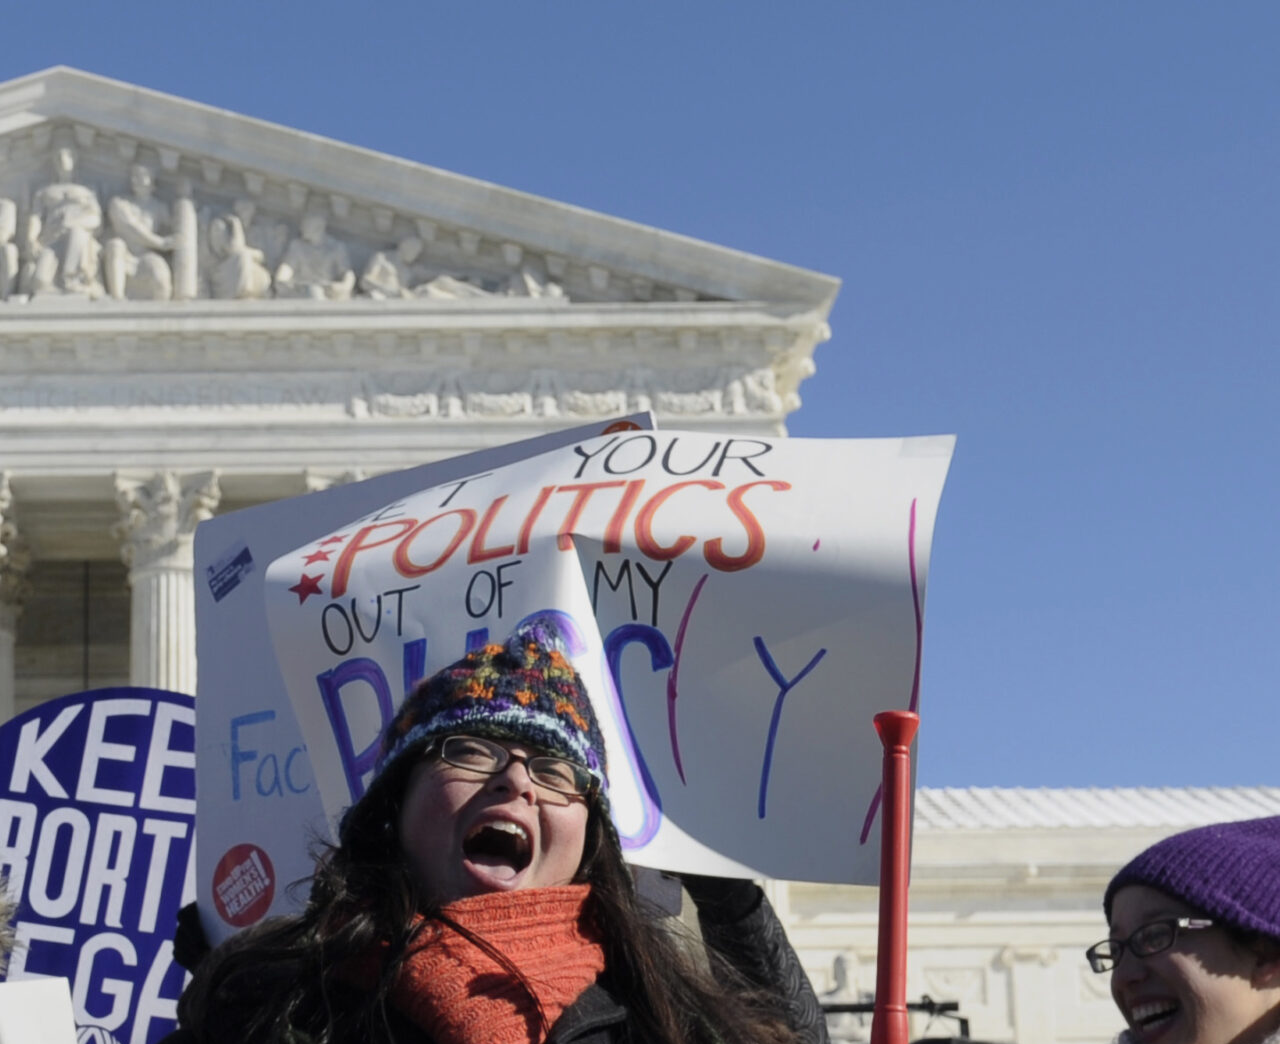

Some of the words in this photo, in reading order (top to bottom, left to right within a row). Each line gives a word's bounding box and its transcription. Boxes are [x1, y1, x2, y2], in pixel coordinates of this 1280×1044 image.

[574, 435, 773, 478] YOUR
[331, 479, 792, 598] POLITICS
[322, 585, 421, 656] OUT
[465, 560, 522, 618] OF
[593, 560, 672, 626] MY
